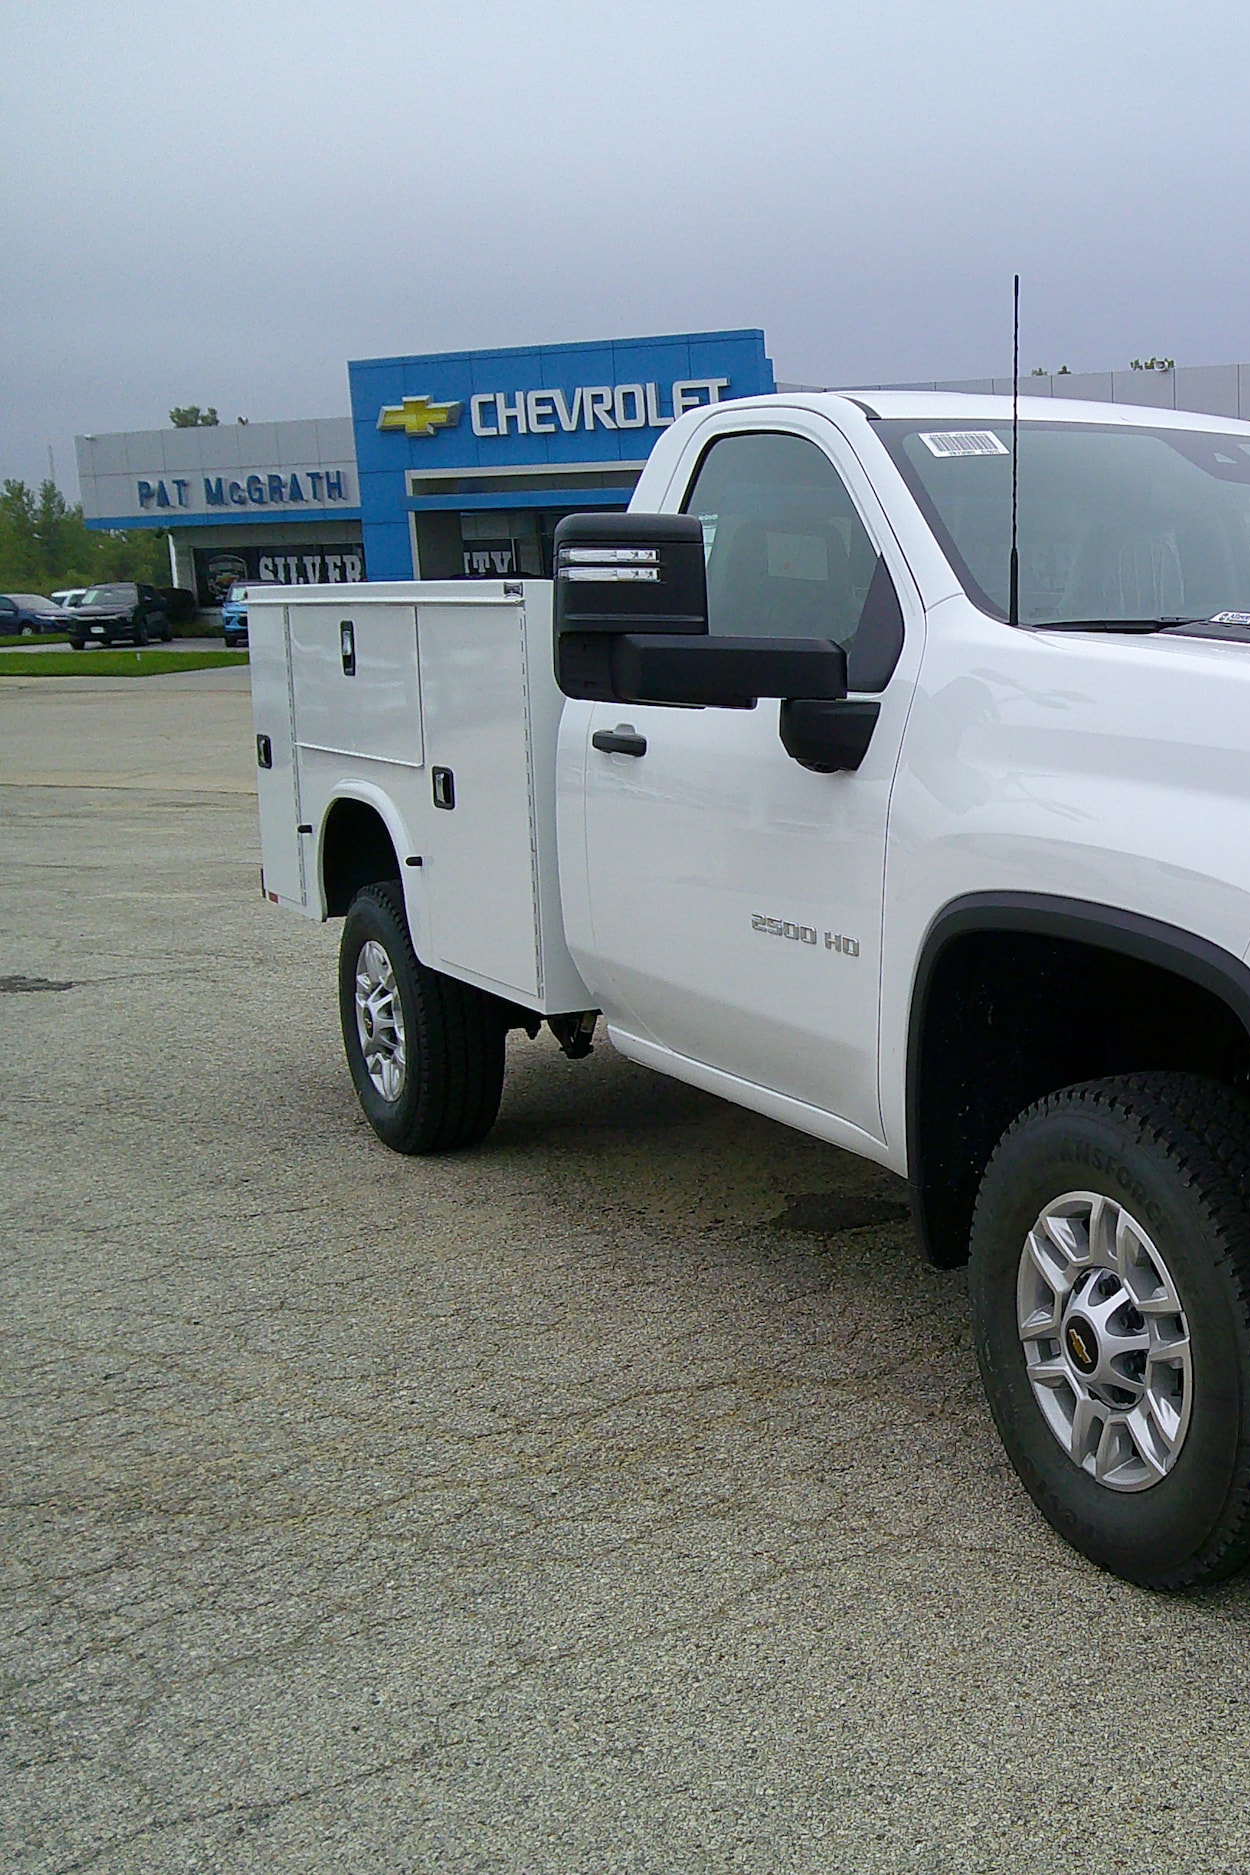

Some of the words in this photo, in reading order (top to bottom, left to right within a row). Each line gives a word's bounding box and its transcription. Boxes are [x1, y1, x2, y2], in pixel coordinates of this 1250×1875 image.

[471, 378, 730, 436] CHEVROLET
[137, 479, 188, 508] PAT
[259, 555, 362, 584] SILVER
[751, 911, 818, 945] 2500
[824, 930, 860, 957] HD
